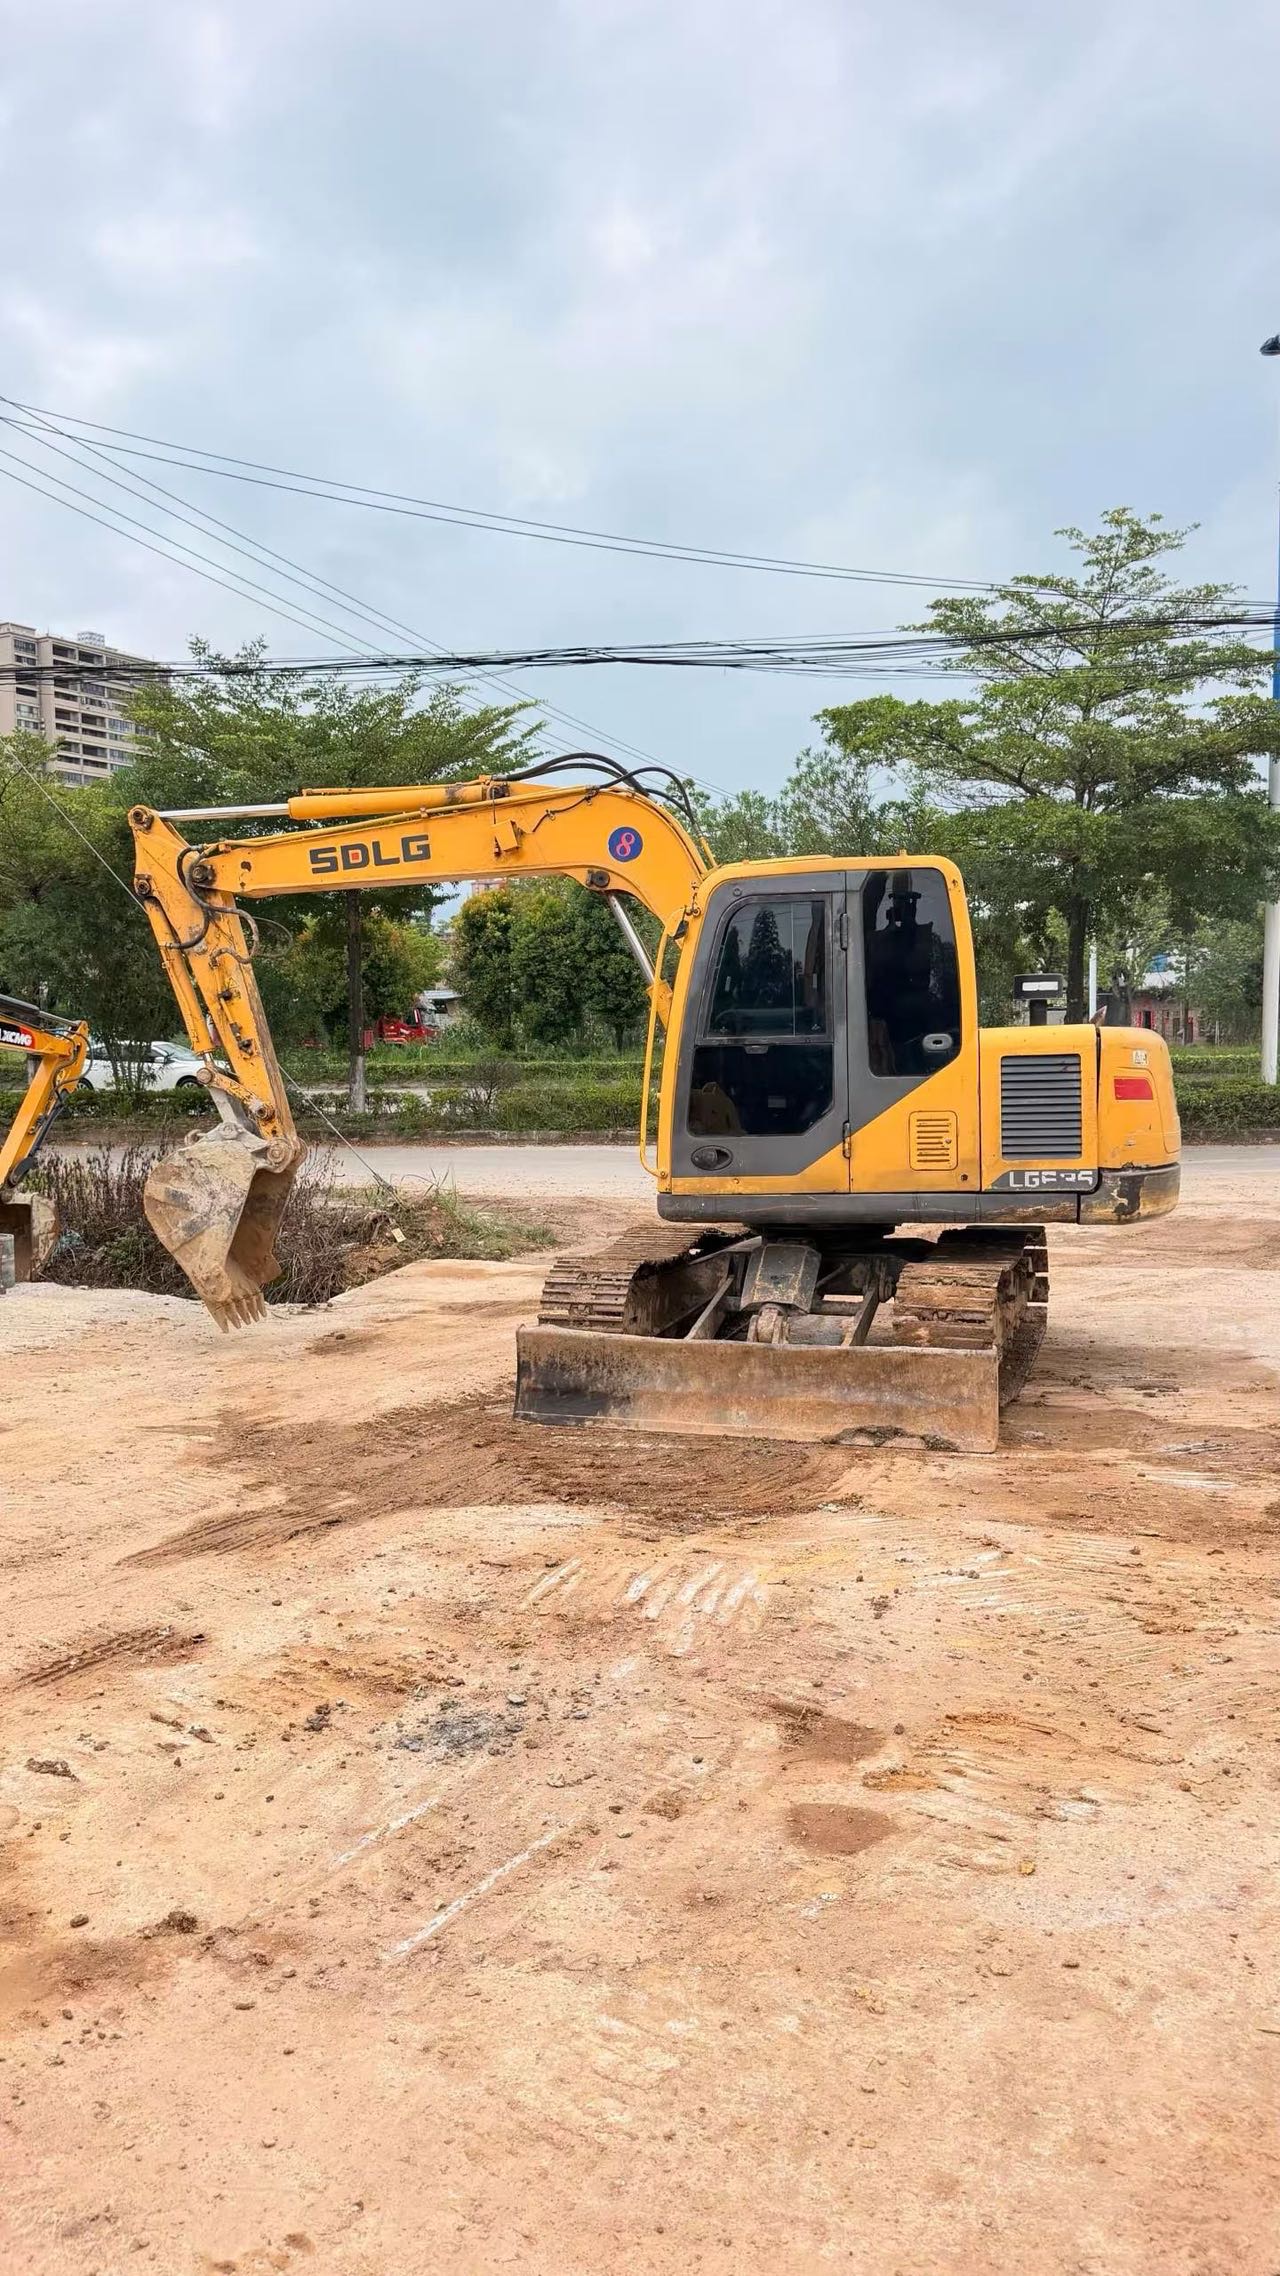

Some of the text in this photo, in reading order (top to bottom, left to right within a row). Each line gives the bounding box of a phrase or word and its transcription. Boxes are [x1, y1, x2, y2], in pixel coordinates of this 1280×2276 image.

[309, 834, 432, 875] SDLG
[616, 832, 636, 857] 8
[1, 1030, 33, 1047] XCMG
